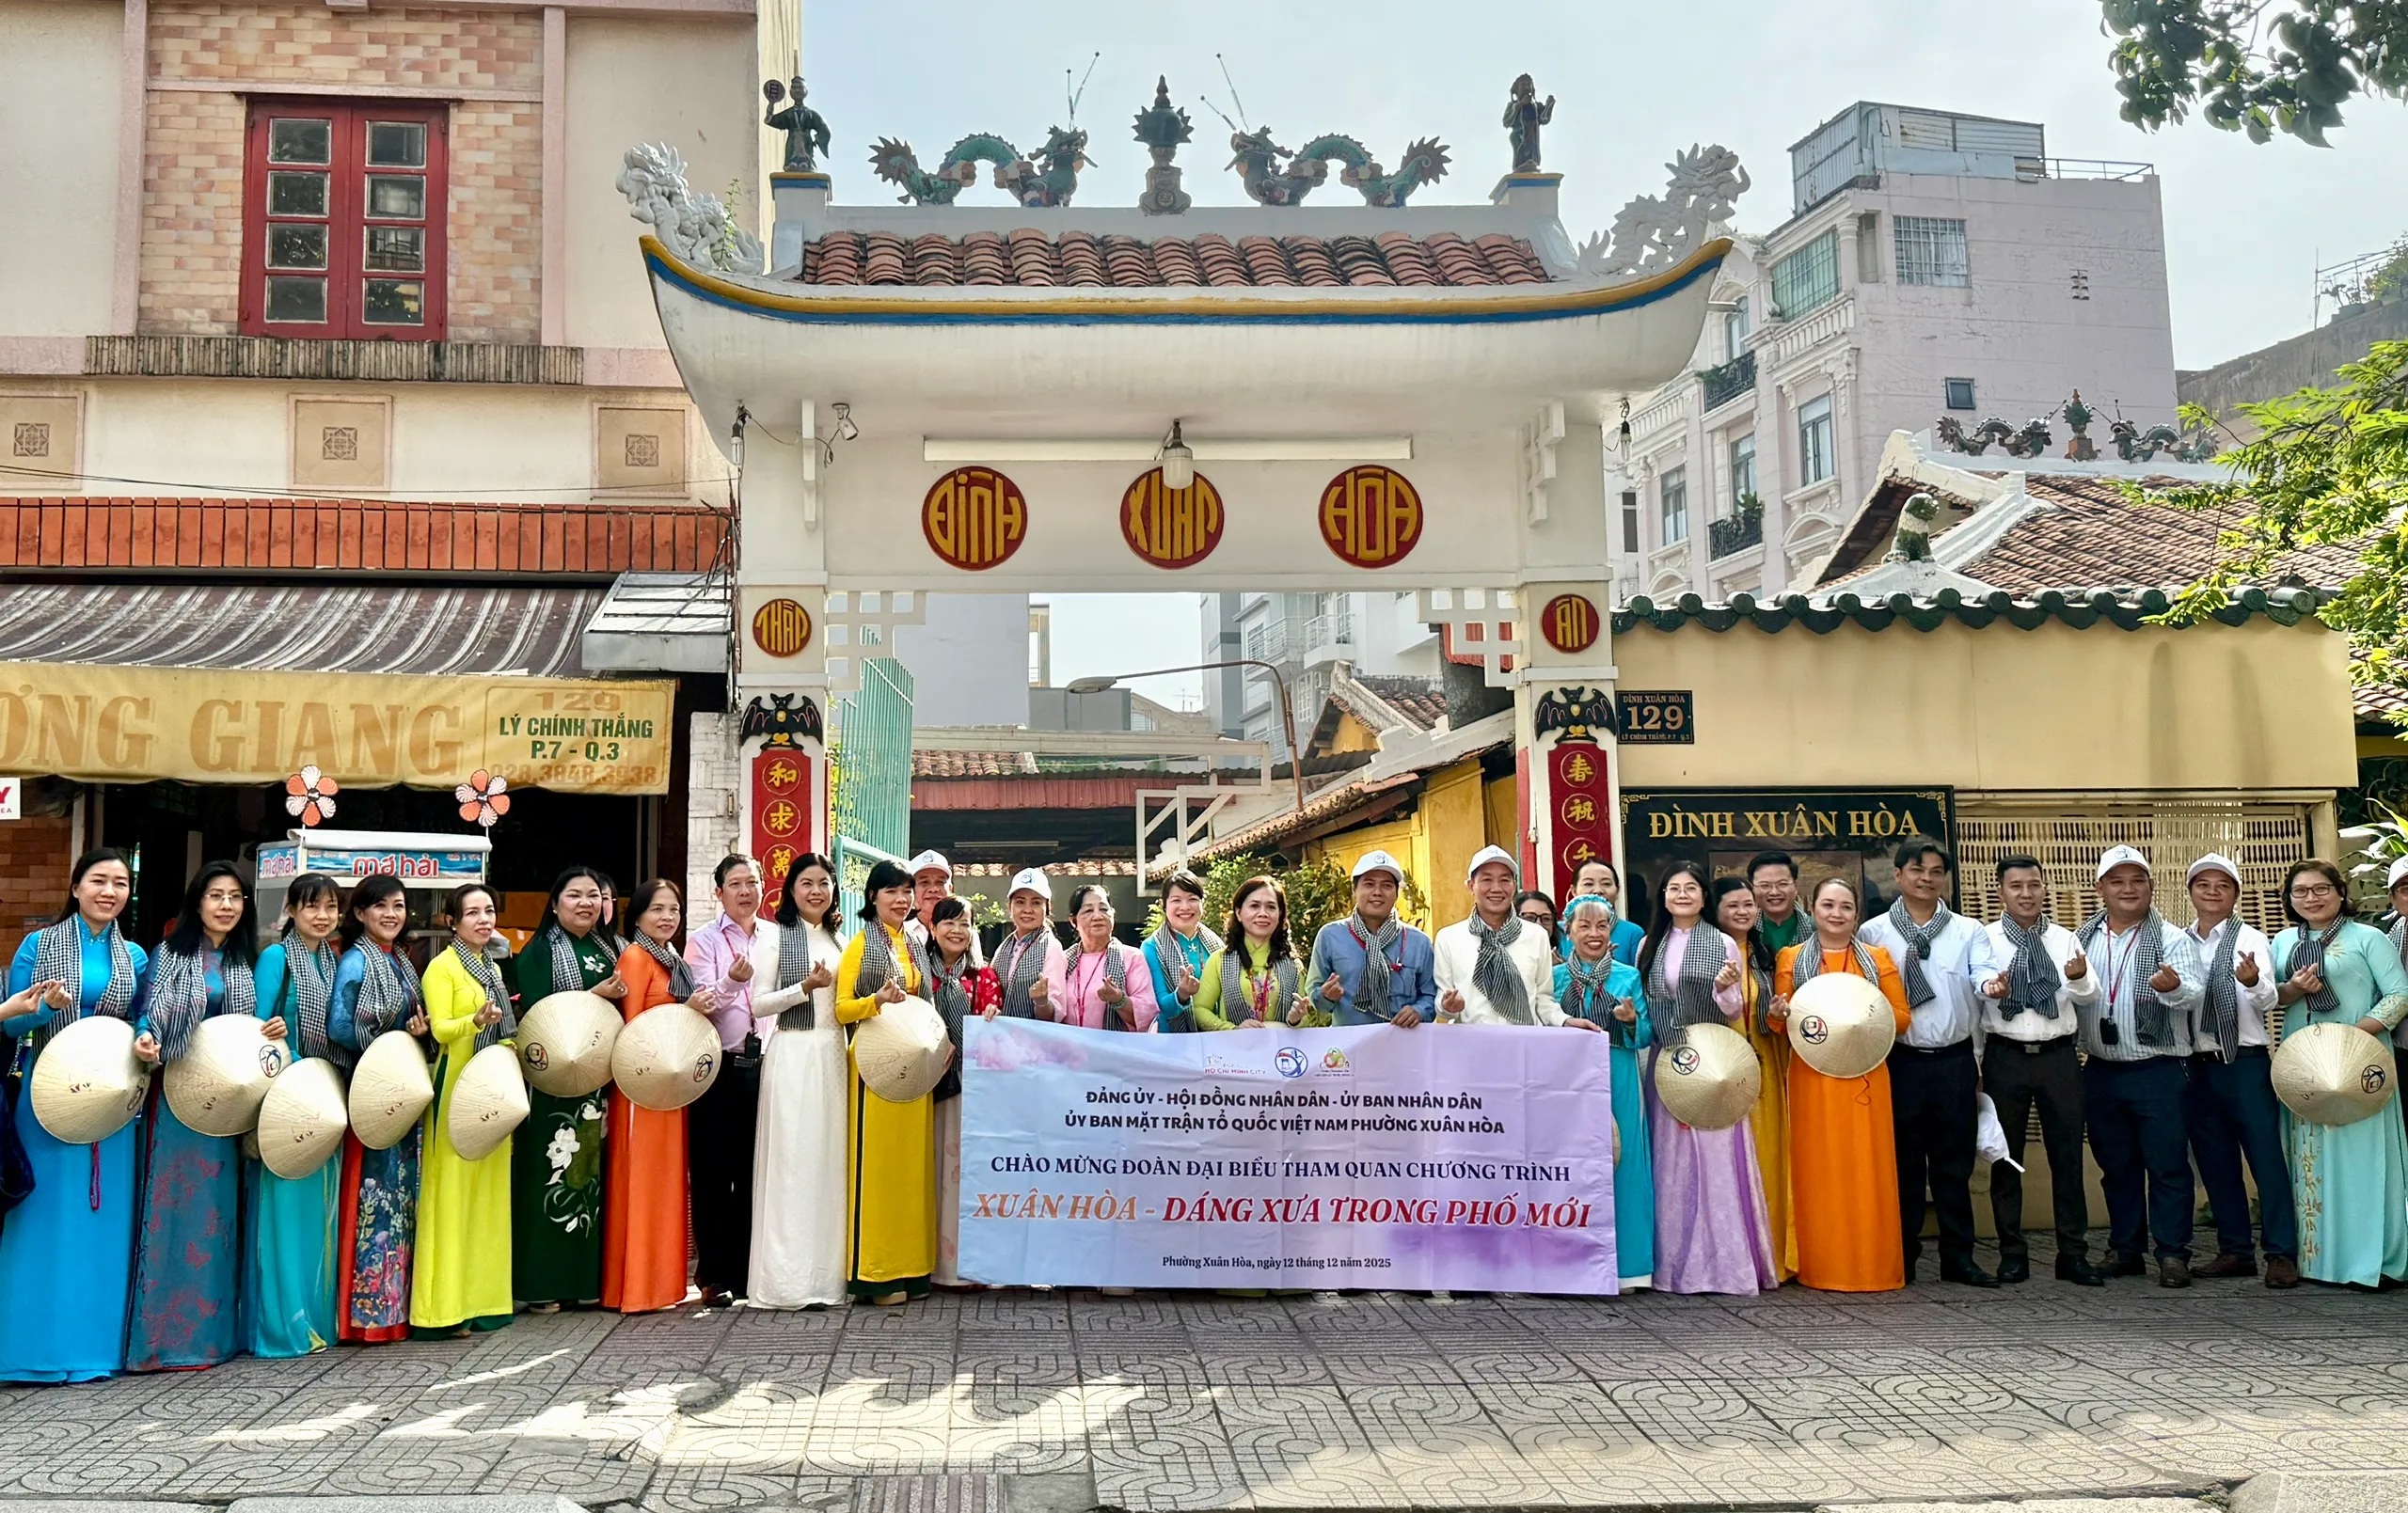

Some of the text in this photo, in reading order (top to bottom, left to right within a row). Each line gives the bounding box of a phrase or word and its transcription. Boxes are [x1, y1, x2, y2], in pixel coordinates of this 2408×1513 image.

[536, 691, 622, 712] 129
[499, 712, 654, 738] LÝ CHÍNH THẮNG
[1626, 705, 1685, 731] 129
[189, 699, 465, 777] GIANG
[531, 740, 562, 760] P.7
[585, 741, 620, 763] Q.3
[1648, 801, 1921, 838] ĐÌNH XUÂN HÒA
[1085, 1086, 1131, 1104] ĐẢNG
[1133, 1087, 1155, 1104] ỦY
[1166, 1088, 1196, 1110] HỘI
[1199, 1085, 1246, 1107] ĐỒNG
[1249, 1090, 1294, 1108] NHÂN
[1298, 1090, 1329, 1108] DÂN
[1340, 1090, 1360, 1108] ỦY
[1363, 1095, 1395, 1108] BAN
[1398, 1091, 1444, 1109] NHÂN
[1448, 1092, 1482, 1110] DÂN
[1065, 1109, 1505, 1135] ỦY BAN MẶT TRẬN TỔ QUỐC VIỆT NAM PHƯỜNG XUÂN HÒA
[990, 1153, 1571, 1182] CHÀO MỪNG ĐOÀN ĐẠI BIỂU THAM QUAN CHƯƠNG TRÌNH
[972, 1188, 1064, 1220] XUÂN
[1067, 1189, 1138, 1221] HÒA
[1162, 1190, 1254, 1223] DÁNG
[1258, 1193, 1321, 1223] XƯA
[1329, 1197, 1439, 1225] TRONG
[1444, 1191, 1519, 1226] PHỐ
[1523, 1195, 1592, 1228] MỚI
[1163, 1256, 1391, 1269] Phường Xuân Hòa, ngày 12 tháng 12 năm 2025
